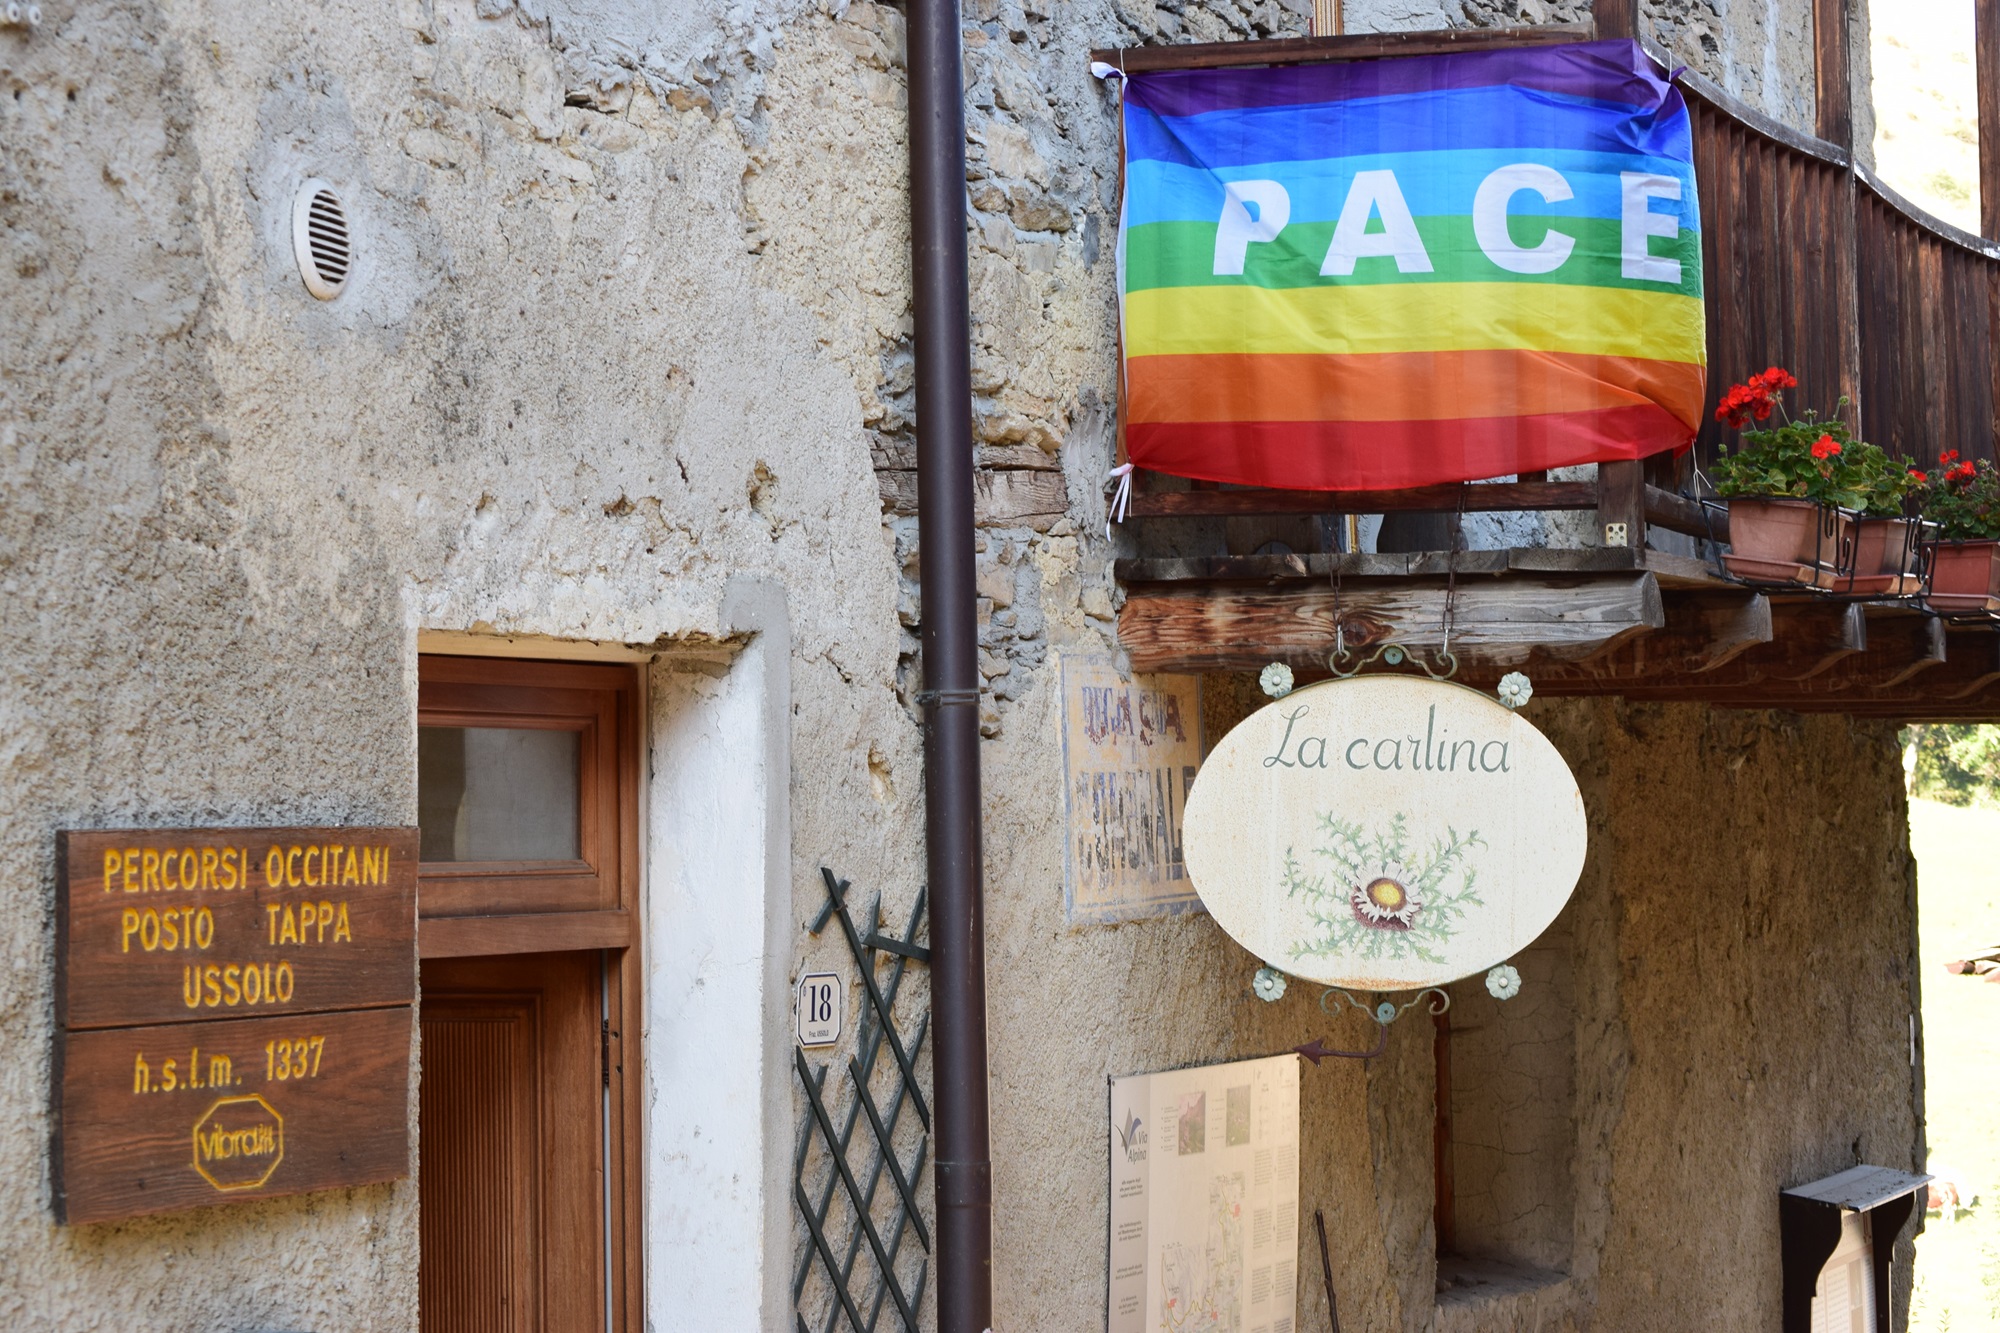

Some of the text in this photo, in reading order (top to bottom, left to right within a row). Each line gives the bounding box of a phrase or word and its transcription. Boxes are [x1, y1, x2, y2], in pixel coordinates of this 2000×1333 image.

[1212, 163, 1683, 285] PACE
[1263, 703, 1510, 773] La carlina
[103, 844, 389, 893] PERCORSI OCCITANI
[122, 900, 351, 953] POSTO TAPPA
[183, 960, 294, 1008] USSOLO
[808, 984, 832, 1023] 18
[265, 1035, 325, 1081] 1337
[1127, 1148, 1147, 1165] Alpina
[1138, 1131, 1148, 1145] Via
